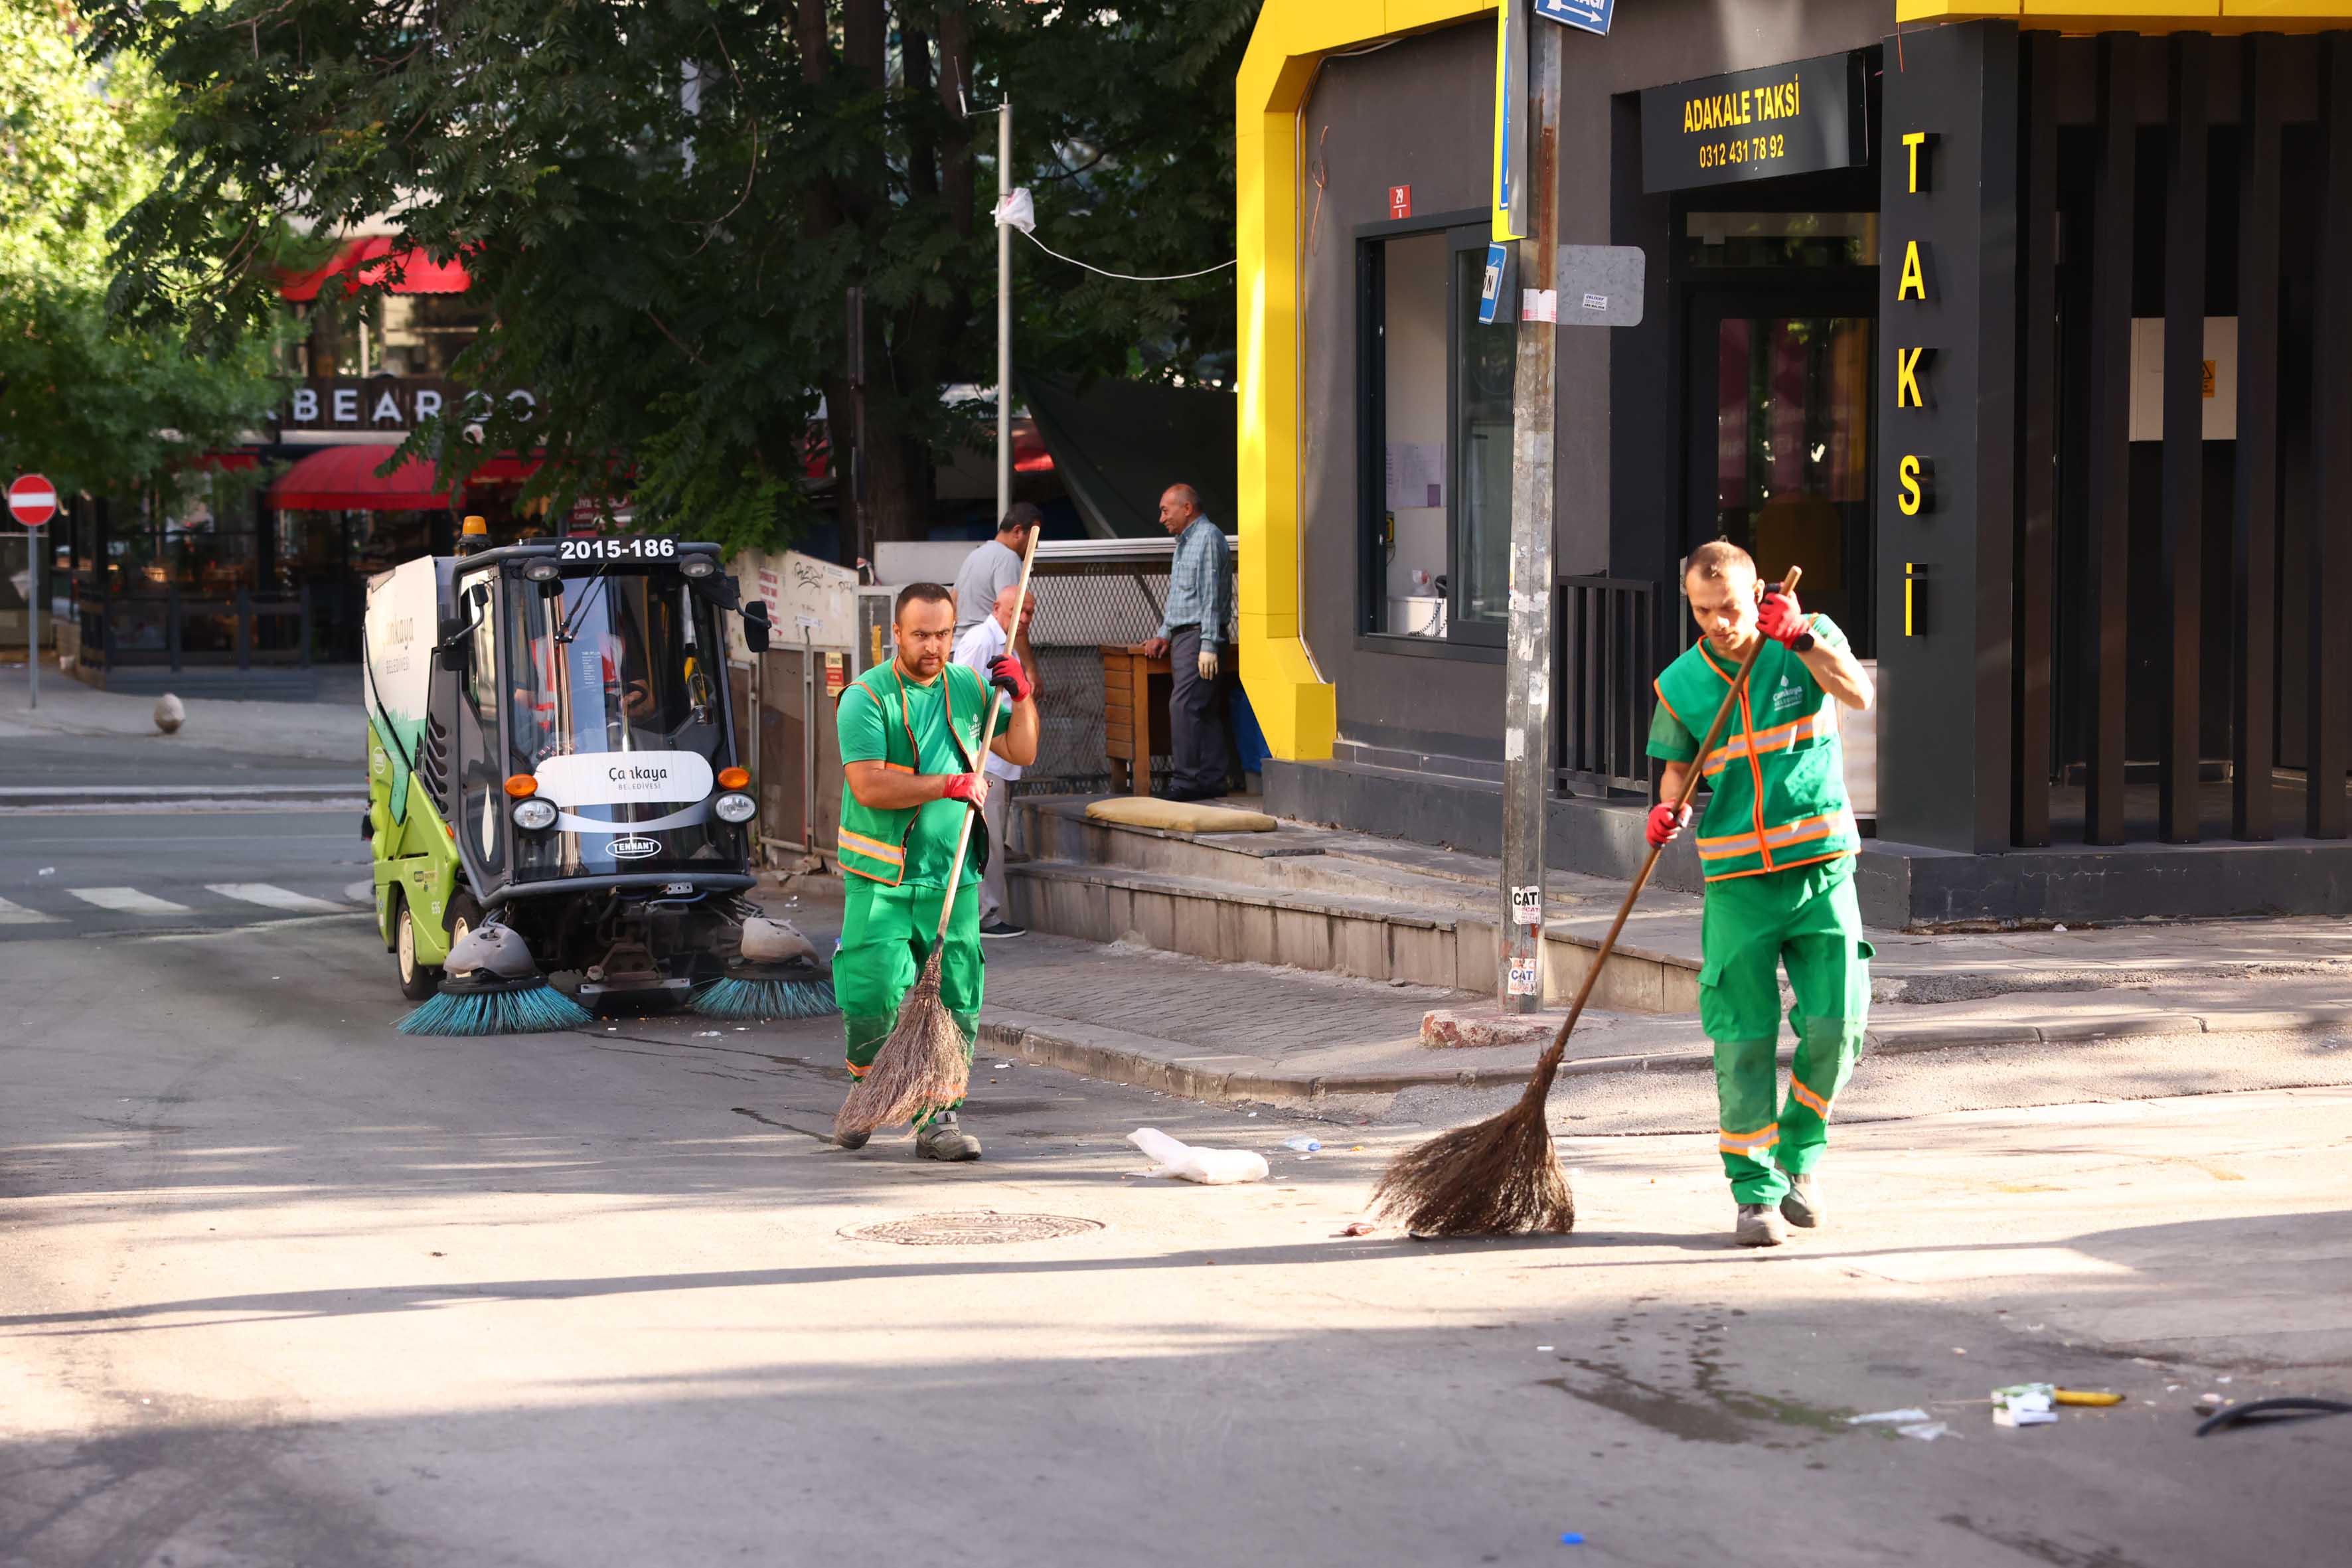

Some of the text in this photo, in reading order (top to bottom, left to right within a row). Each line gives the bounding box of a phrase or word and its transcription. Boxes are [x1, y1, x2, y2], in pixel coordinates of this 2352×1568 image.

[1684, 73, 1800, 133] ADAKALE TAKSİ
[1699, 134, 1784, 168] 0312 431 78 92
[1395, 188, 1403, 204] 29
[293, 388, 442, 422] BEAR
[561, 539, 674, 560] 2015-186
[613, 842, 655, 854] TENNANT
